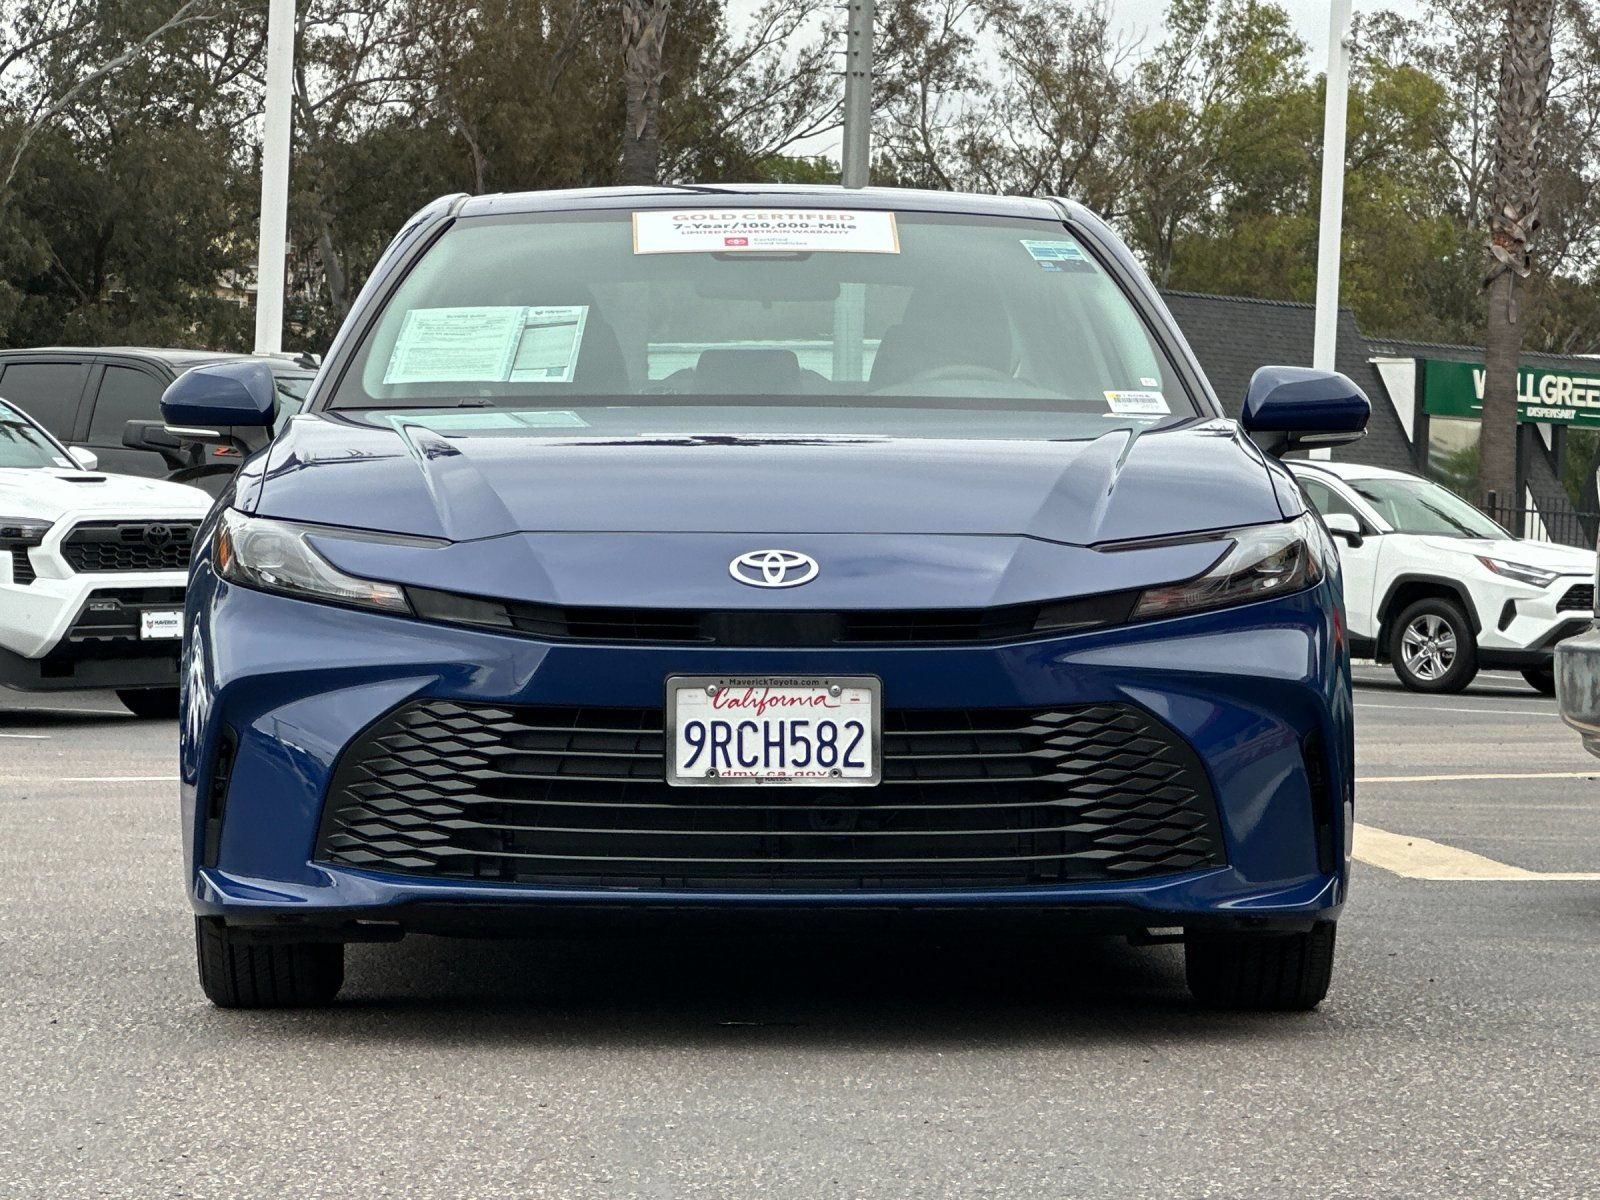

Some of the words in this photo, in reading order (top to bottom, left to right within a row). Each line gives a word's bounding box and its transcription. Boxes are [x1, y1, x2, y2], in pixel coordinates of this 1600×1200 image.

[741, 213, 855, 221] CERTIFIED
[673, 222, 857, 230] 7-Year/100,000-Mile
[1526, 406, 1577, 419] DISPENSARY
[729, 678, 820, 686] MaverickToyota.com
[713, 687, 841, 716] California
[683, 720, 865, 769] 9RCH582
